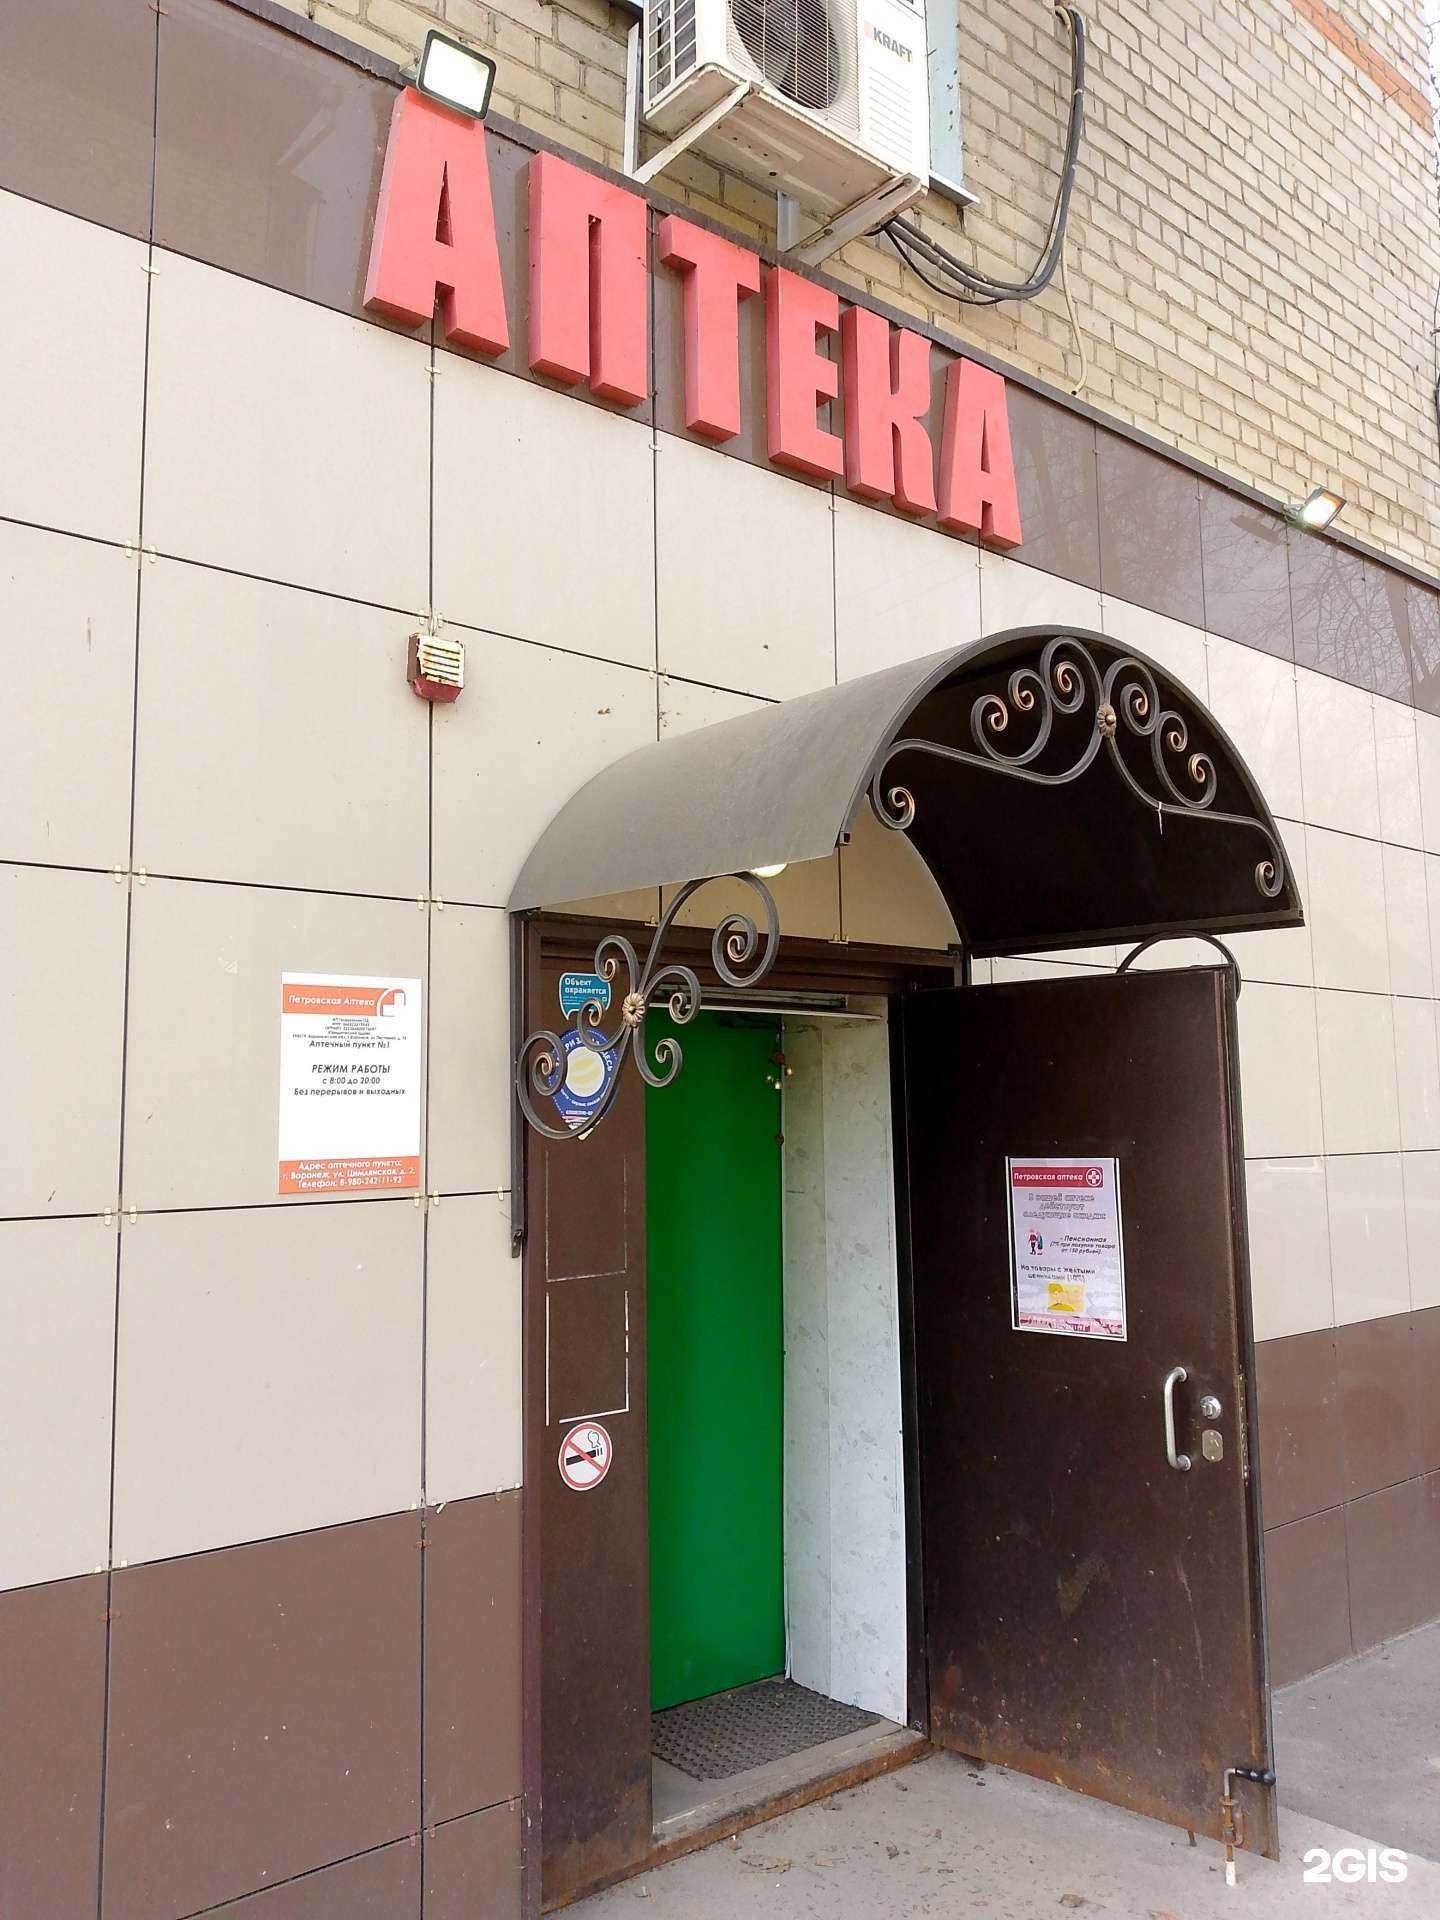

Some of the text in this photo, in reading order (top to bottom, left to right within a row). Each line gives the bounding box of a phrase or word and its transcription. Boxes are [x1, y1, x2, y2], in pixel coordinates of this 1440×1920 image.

[872, 27, 912, 62] KRAFT
[363, 87, 1022, 550] АПТЕКА
[565, 987, 606, 995] охраняется
[288, 995, 375, 1007] Петровская Аптека
[309, 1040, 351, 1048] Аптечный
[352, 1041, 376, 1049] пункт
[311, 1064, 391, 1073] РЕЖИМ РАБОТЫ
[299, 1161, 326, 1171] Адрес
[328, 1161, 370, 1169] аптечного
[1031, 1265, 1056, 1273] товары
